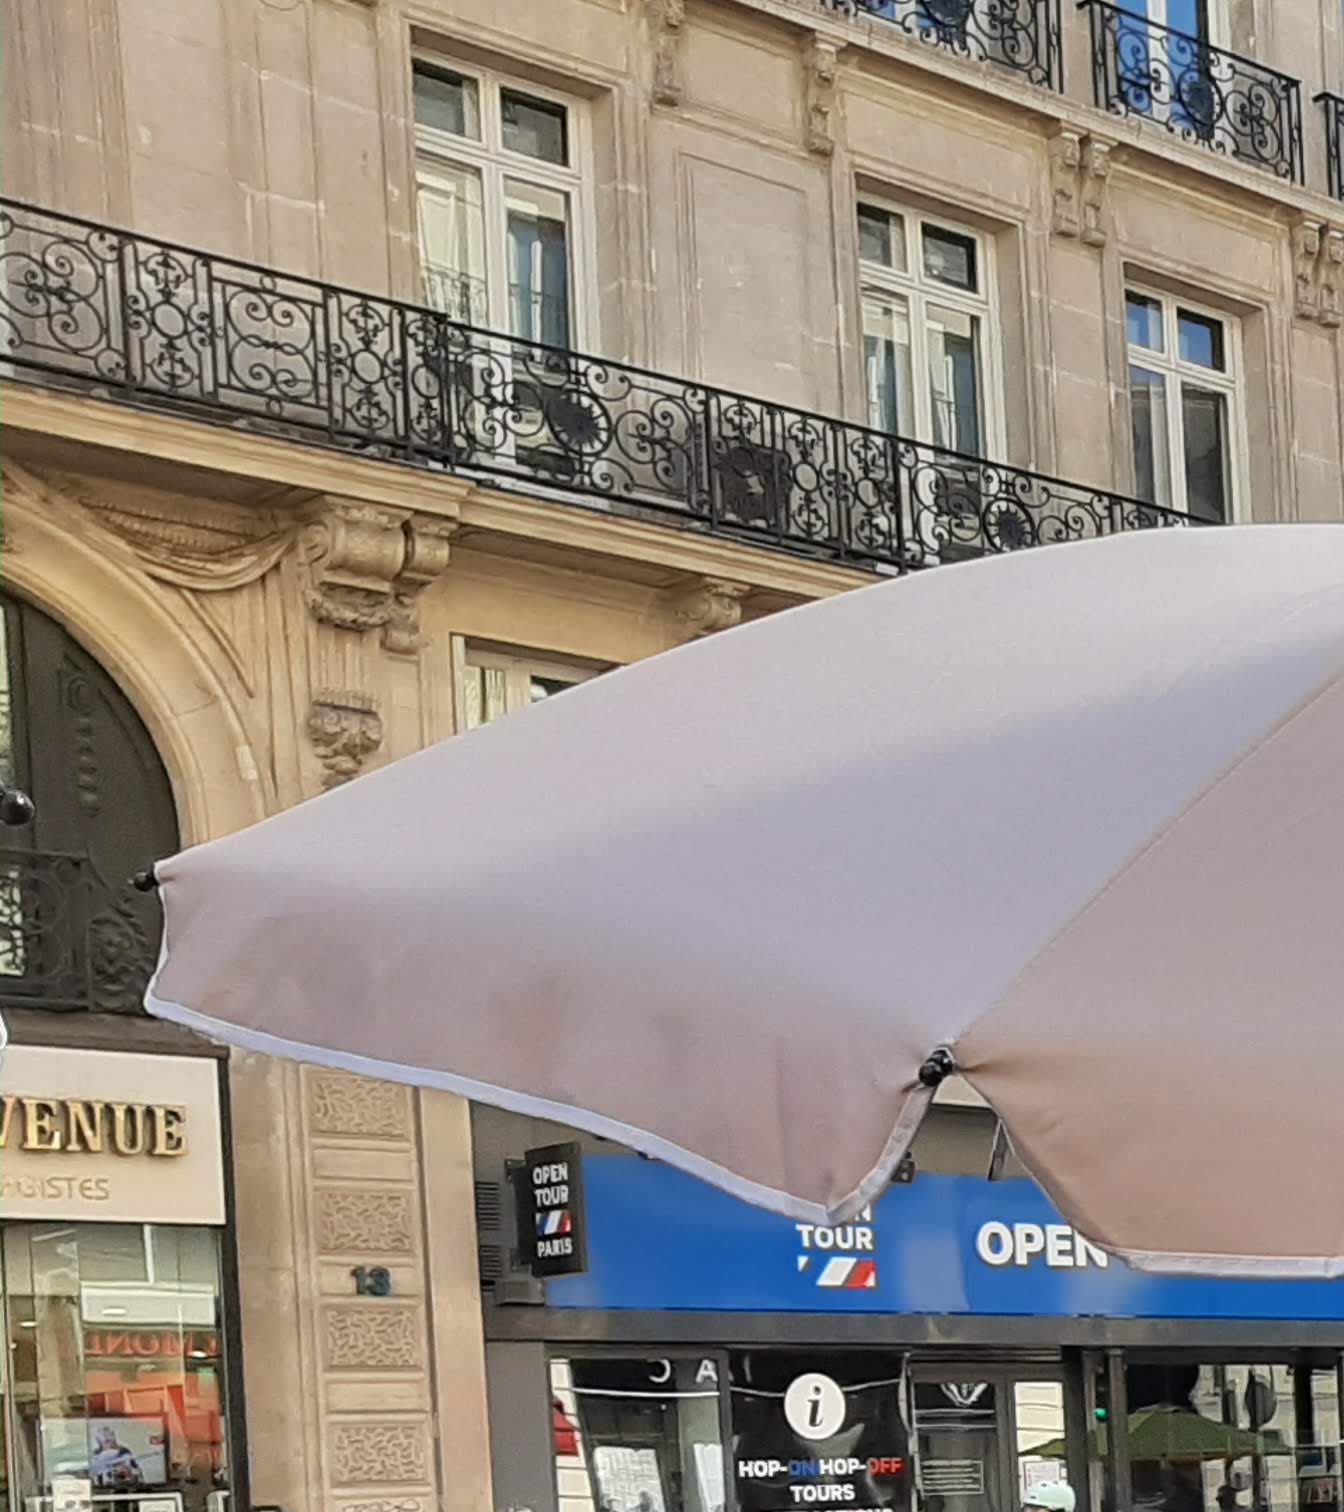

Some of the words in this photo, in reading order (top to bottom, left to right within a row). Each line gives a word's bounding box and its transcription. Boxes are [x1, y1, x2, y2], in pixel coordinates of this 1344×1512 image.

[532, 1162, 568, 1185] OPEN
[534, 1184, 569, 1207] TOUR
[536, 1237, 573, 1258] PARIS
[794, 1223, 875, 1250] TOUR
[738, 1459, 819, 1478] HOP-ON
[819, 1456, 902, 1477] HOP-OFF
[789, 1483, 856, 1502] TOURS
